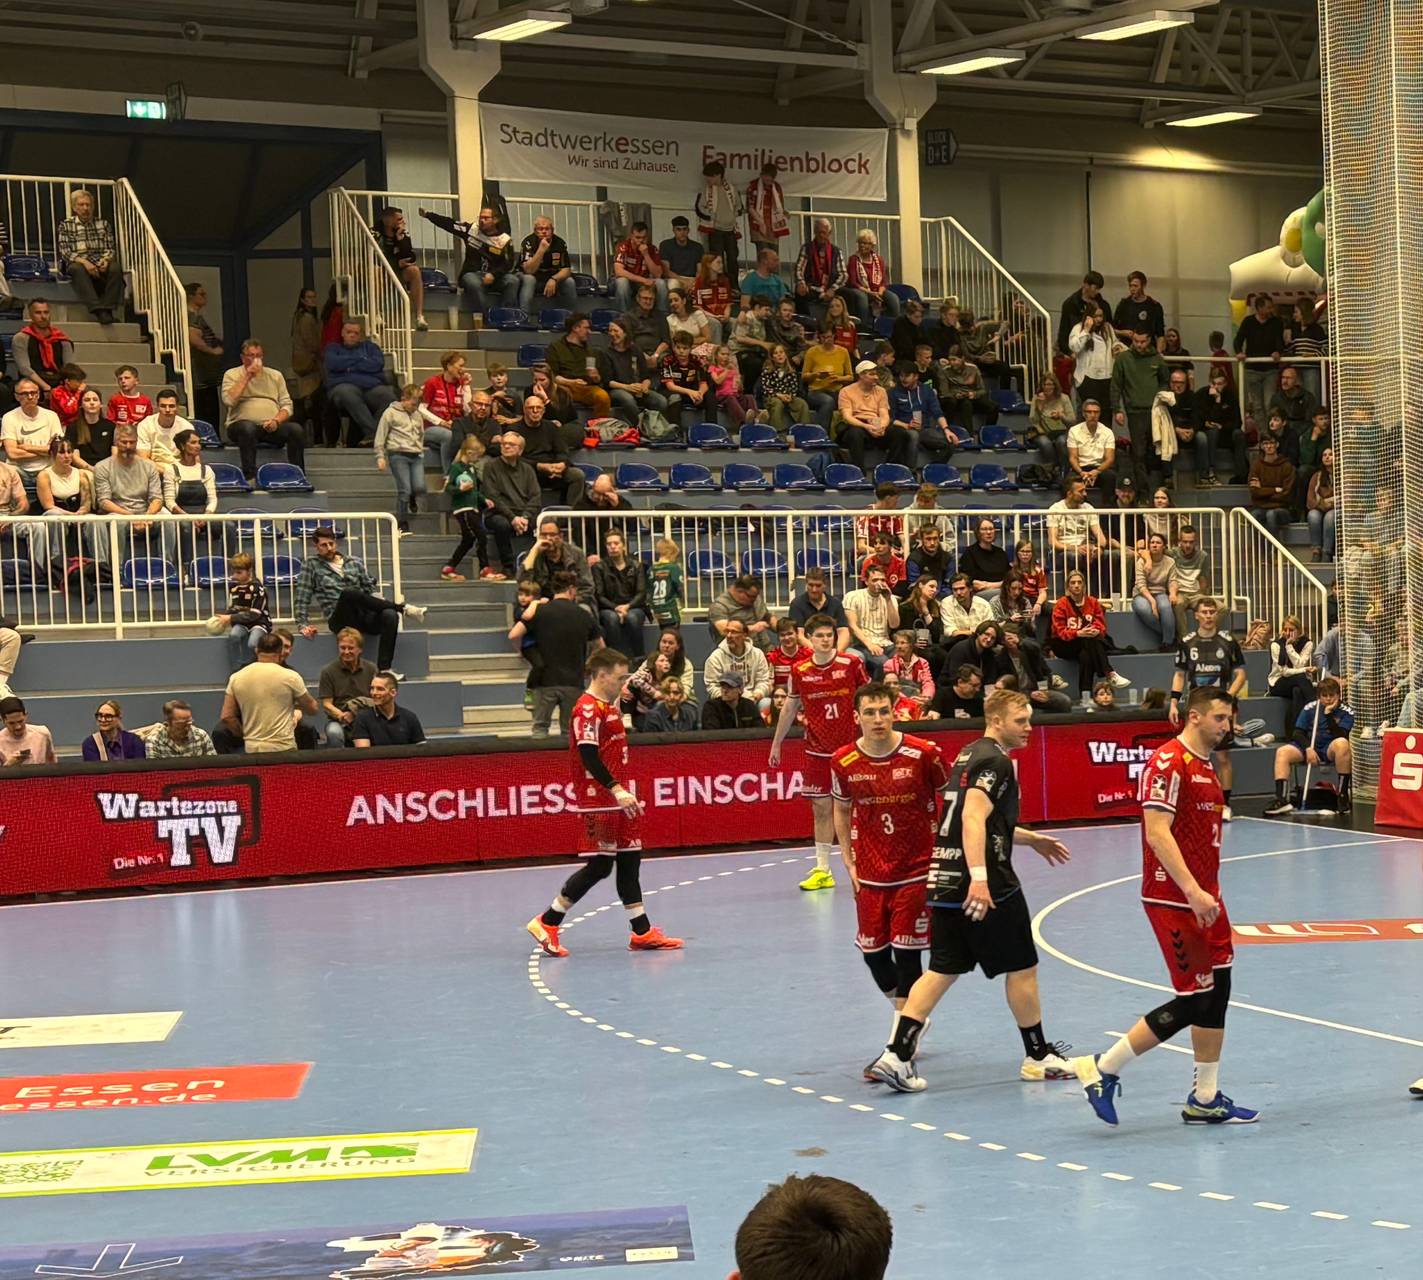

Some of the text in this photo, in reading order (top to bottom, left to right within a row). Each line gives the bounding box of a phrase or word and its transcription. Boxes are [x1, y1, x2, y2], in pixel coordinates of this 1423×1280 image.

[500, 123, 680, 157] Stadtwerkessen
[567, 154, 680, 174] Wir sind Zuhause.
[702, 146, 870, 175] Familienblock
[1189, 647, 1199, 661] 6
[824, 703, 840, 720] 21
[98, 792, 238, 819] Wartezone
[939, 791, 959, 837] 7
[880, 813, 895, 835] 3
[157, 814, 242, 867] TV
[15, 1078, 226, 1099] Essen
[143, 1158, 418, 1178] VERSICHERUNG
[145, 1146, 332, 1171] LVM
